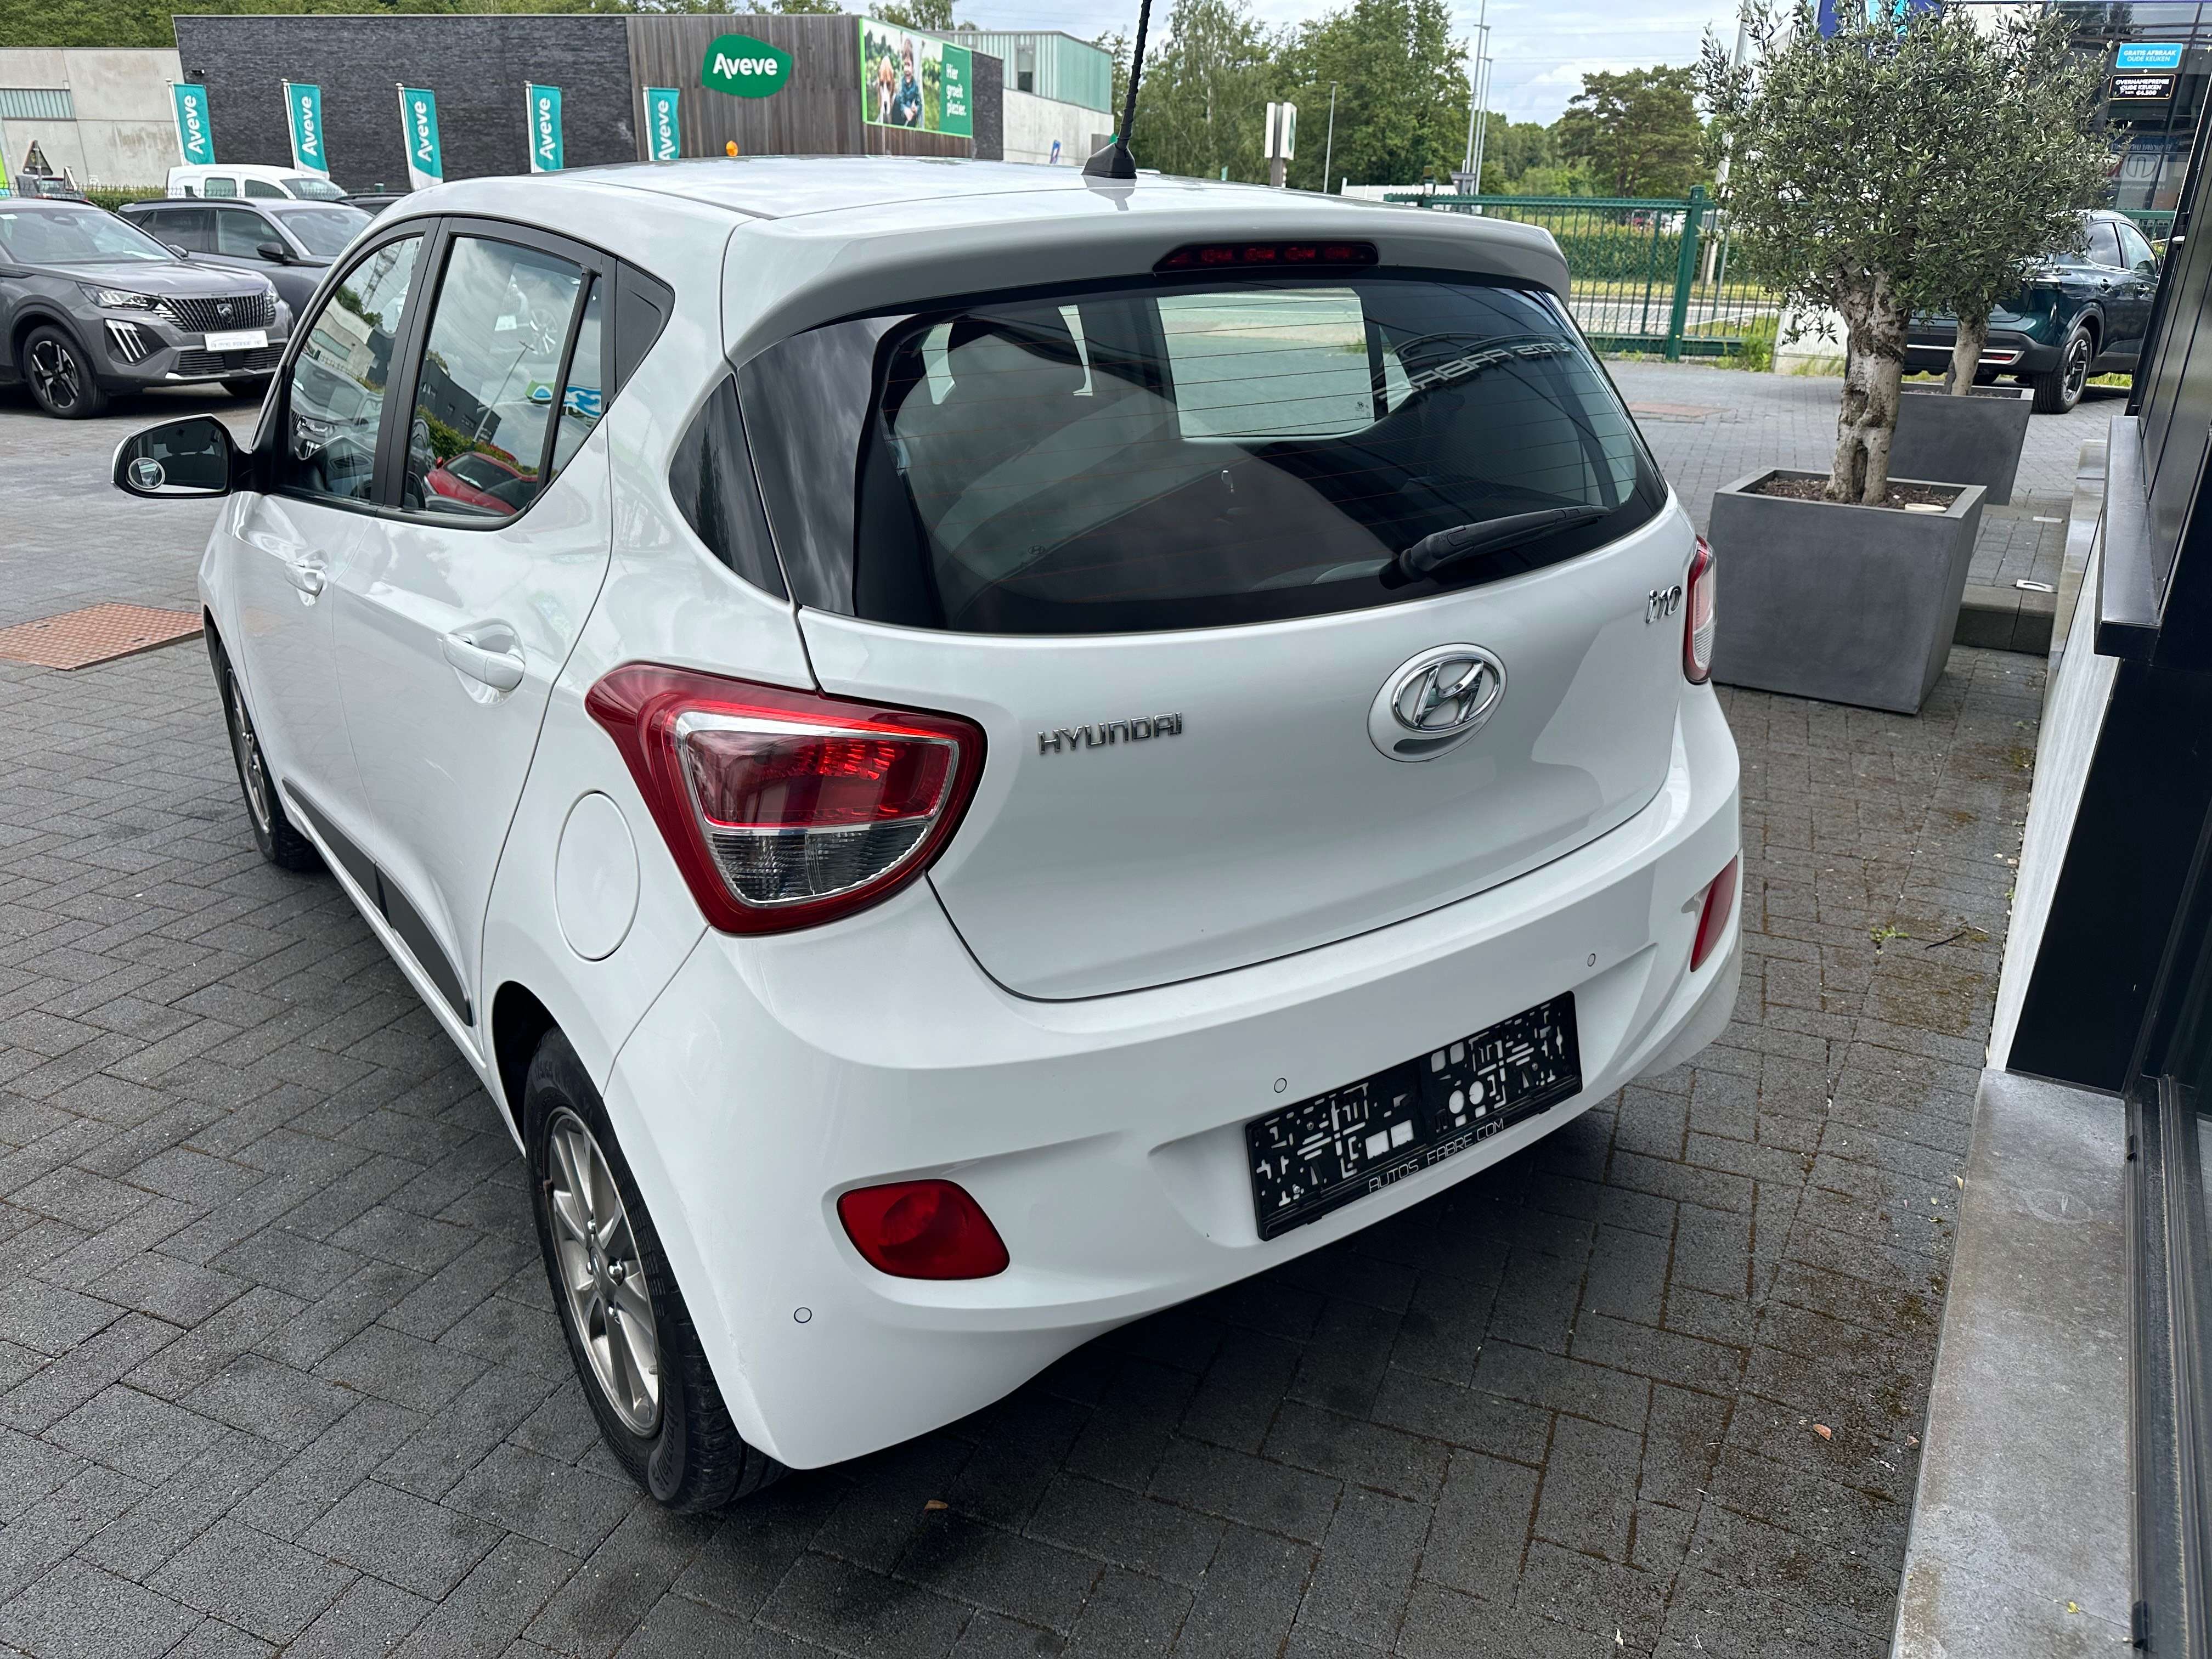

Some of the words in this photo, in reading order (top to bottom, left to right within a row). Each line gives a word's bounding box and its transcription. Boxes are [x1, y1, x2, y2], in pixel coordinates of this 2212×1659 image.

[713, 53, 778, 80] Aveve
[184, 95, 205, 154] Aveve
[301, 96, 317, 156] Aveve
[414, 101, 433, 162] Aveve
[539, 98, 556, 160] Aveve
[658, 100, 676, 160] Aveve
[1646, 585, 1682, 624] i10
[1038, 712, 1182, 755] HYUNDAI
[1369, 1158, 1419, 1193] AUTOS
[1426, 1118, 1504, 1166] FABRE.COM
